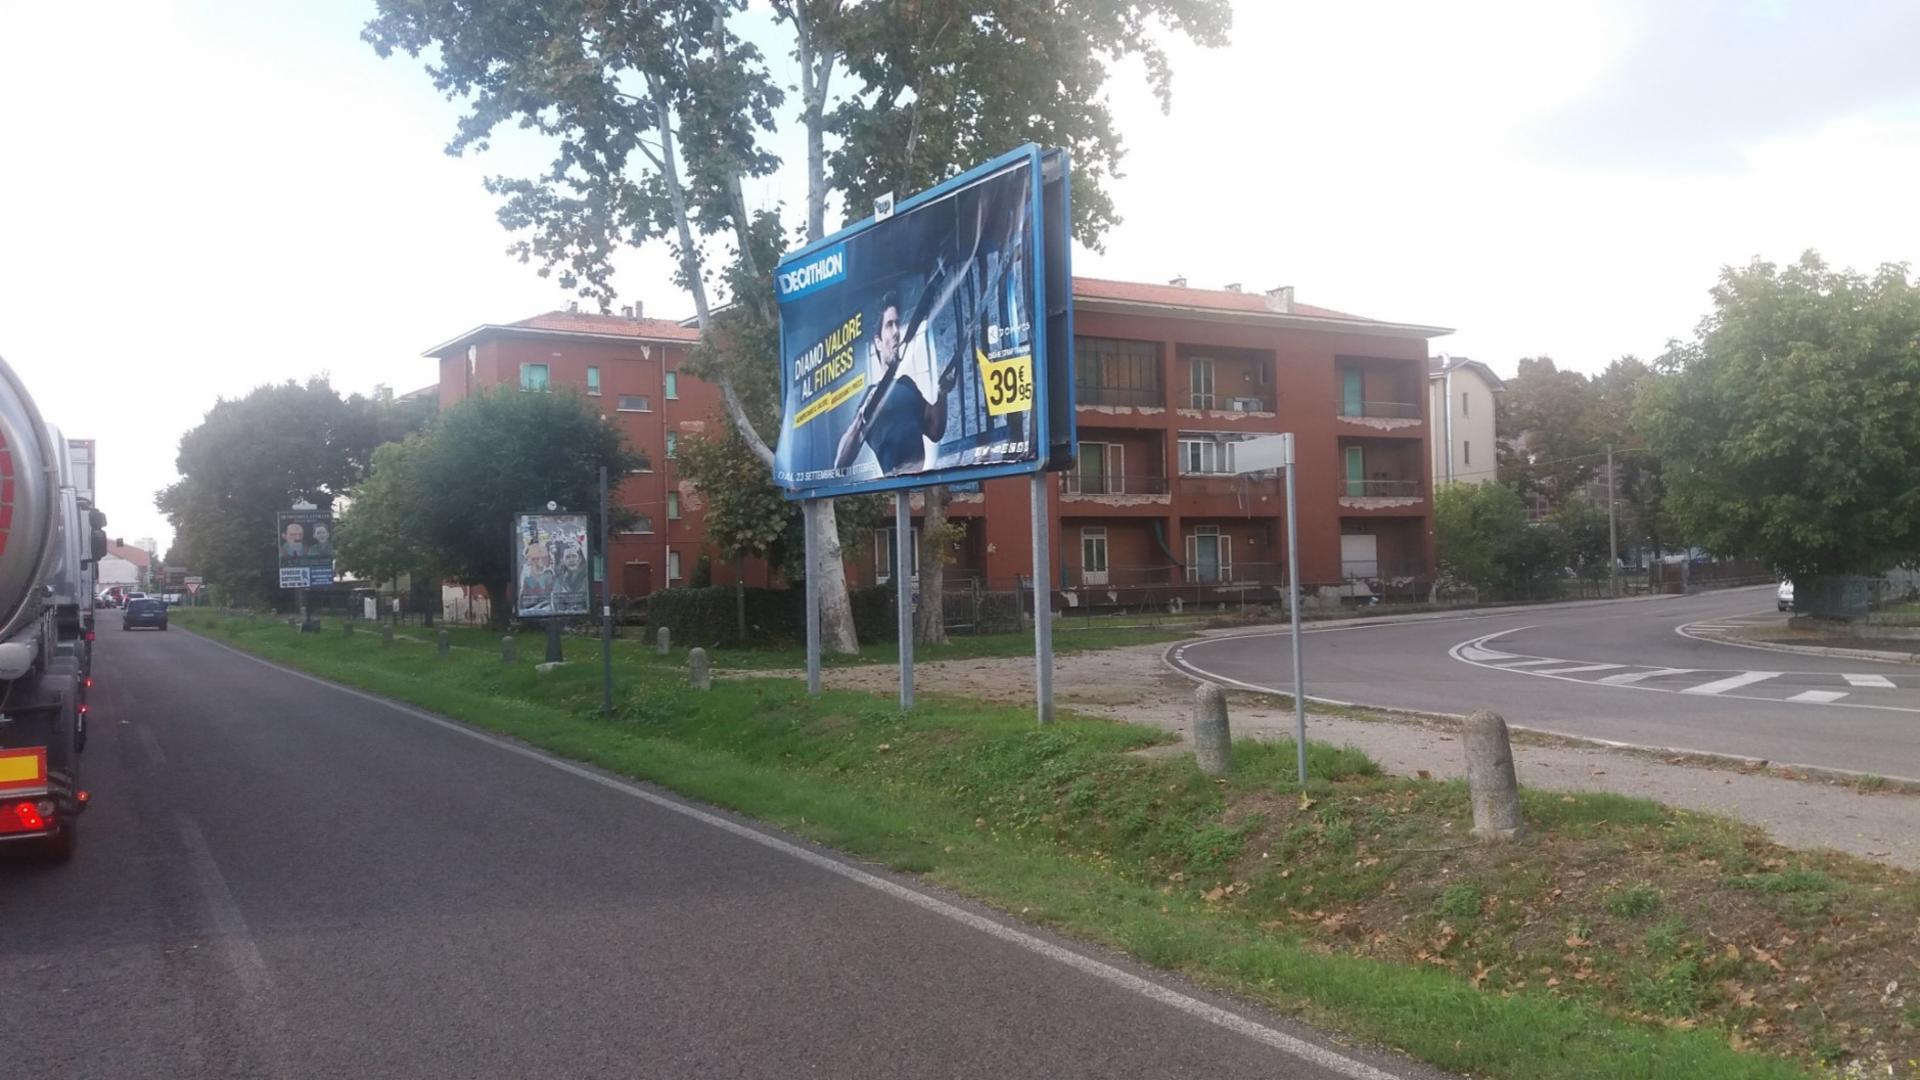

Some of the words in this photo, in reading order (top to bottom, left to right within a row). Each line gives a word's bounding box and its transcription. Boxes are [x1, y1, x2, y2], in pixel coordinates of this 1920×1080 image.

[779, 252, 842, 294] DECATHLON
[795, 343, 823, 380] DIAMO
[825, 313, 862, 357] VALORE
[801, 376, 813, 401] AL
[815, 347, 853, 391] FITNESS
[990, 366, 1018, 406] 39
[1018, 383, 1032, 401] 95
